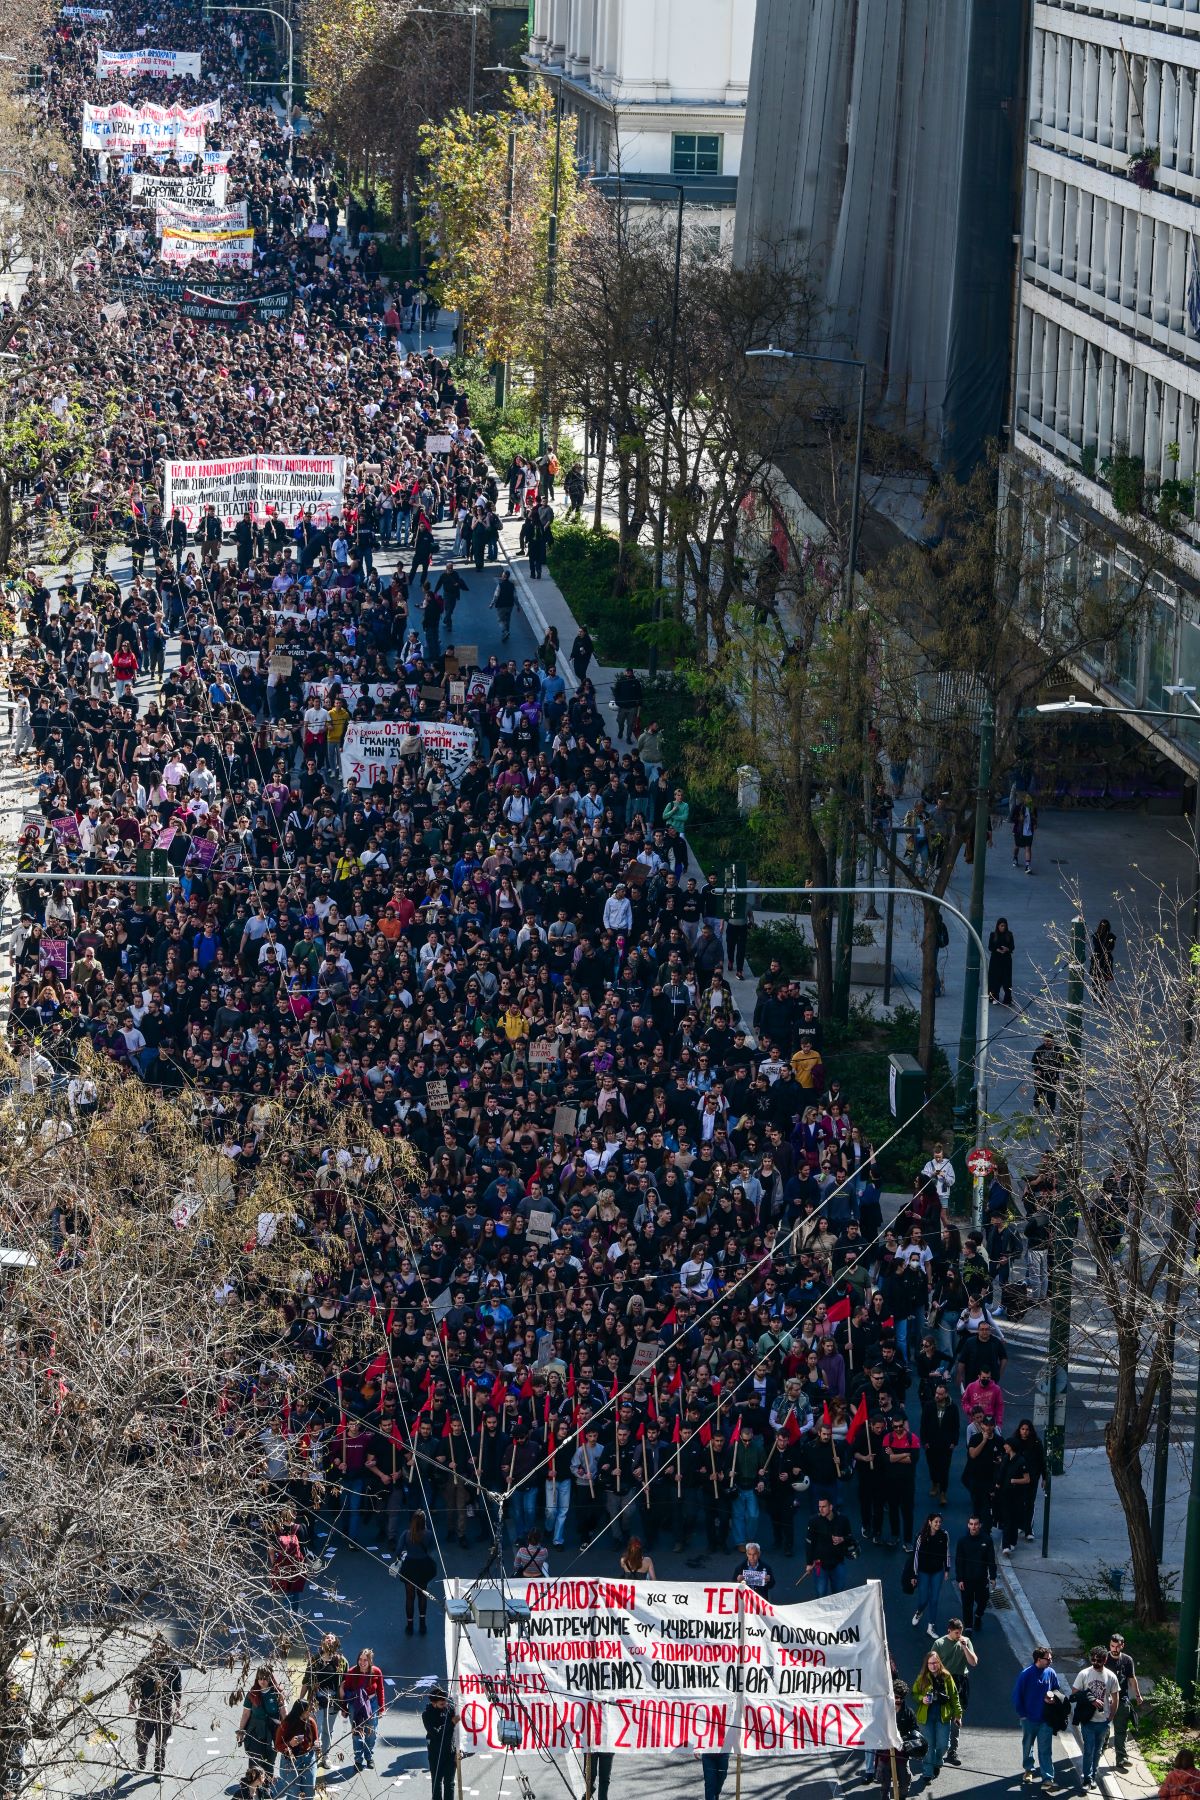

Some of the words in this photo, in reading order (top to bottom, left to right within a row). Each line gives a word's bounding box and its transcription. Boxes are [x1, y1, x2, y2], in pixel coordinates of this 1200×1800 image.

[186, 185, 213, 198] ΘΥΣΙΕΣ
[171, 465, 182, 477] ΓΙΑ
[185, 466, 196, 477] ΝΑ
[285, 459, 335, 473] ΑΝΑΤΡΕΨΟΥΜΕ
[359, 736, 400, 747] ΕΓΚΛΗΜΑ
[363, 747, 385, 756] ΜΗΝ
[526, 1580, 636, 1611] ΔΙΚΑΙΟΣΥΝΗ
[647, 1592, 667, 1605] για
[672, 1594, 689, 1604] τα
[704, 1588, 775, 1617] ΤΕΜΠΗ
[519, 1615, 630, 1638] ΑΝΑΤΡΕΨΟΥΜΕ
[636, 1623, 656, 1638] την
[660, 1619, 742, 1640] ΚΥΒΕΡΝΗΣΗ
[745, 1627, 767, 1637] των
[770, 1624, 861, 1646] ΔΟΛΟΦΟΝΩΝ
[507, 1641, 623, 1663] ΚΡΑΤΙΚΟΠΟΙΗΣΗ
[627, 1645, 647, 1656] του
[651, 1642, 761, 1665] ΣΙΔΗΡΟΔΡΟΜΟΥ
[777, 1648, 826, 1668] ΤΩΡΑ
[565, 1661, 644, 1691] ΚΑΝΕΝΑΣ
[651, 1660, 720, 1690] ΦΟΙΤΗΤΗΣ
[779, 1668, 863, 1695] ΔΙΑΓΡΑΦΕΙ
[614, 1699, 727, 1750] ΣΥΛΛΟΓΩΝ
[743, 1703, 866, 1751] ΑΘΗΝΑΣ
